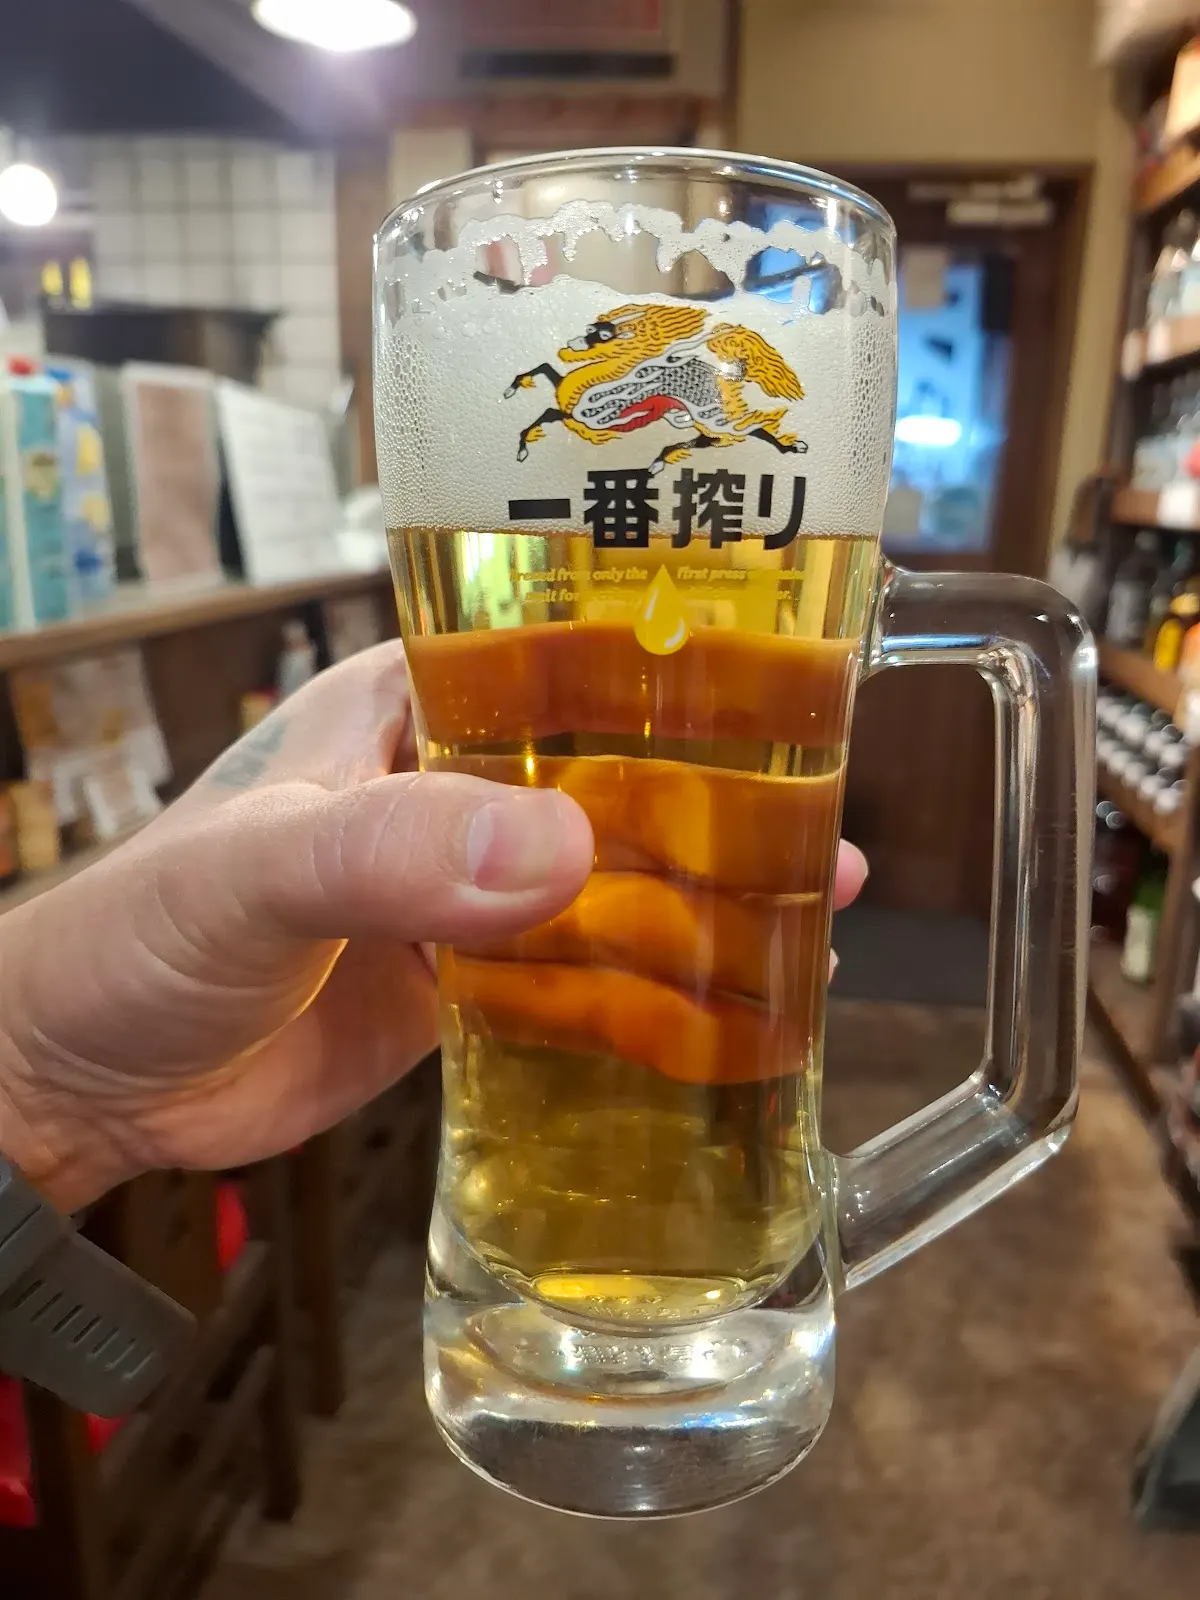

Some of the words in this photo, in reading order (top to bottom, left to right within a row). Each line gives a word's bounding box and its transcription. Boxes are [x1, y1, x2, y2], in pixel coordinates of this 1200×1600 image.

[508, 468, 806, 550] 一番搾り
[592, 567, 624, 583] only
[625, 567, 648, 580] the
